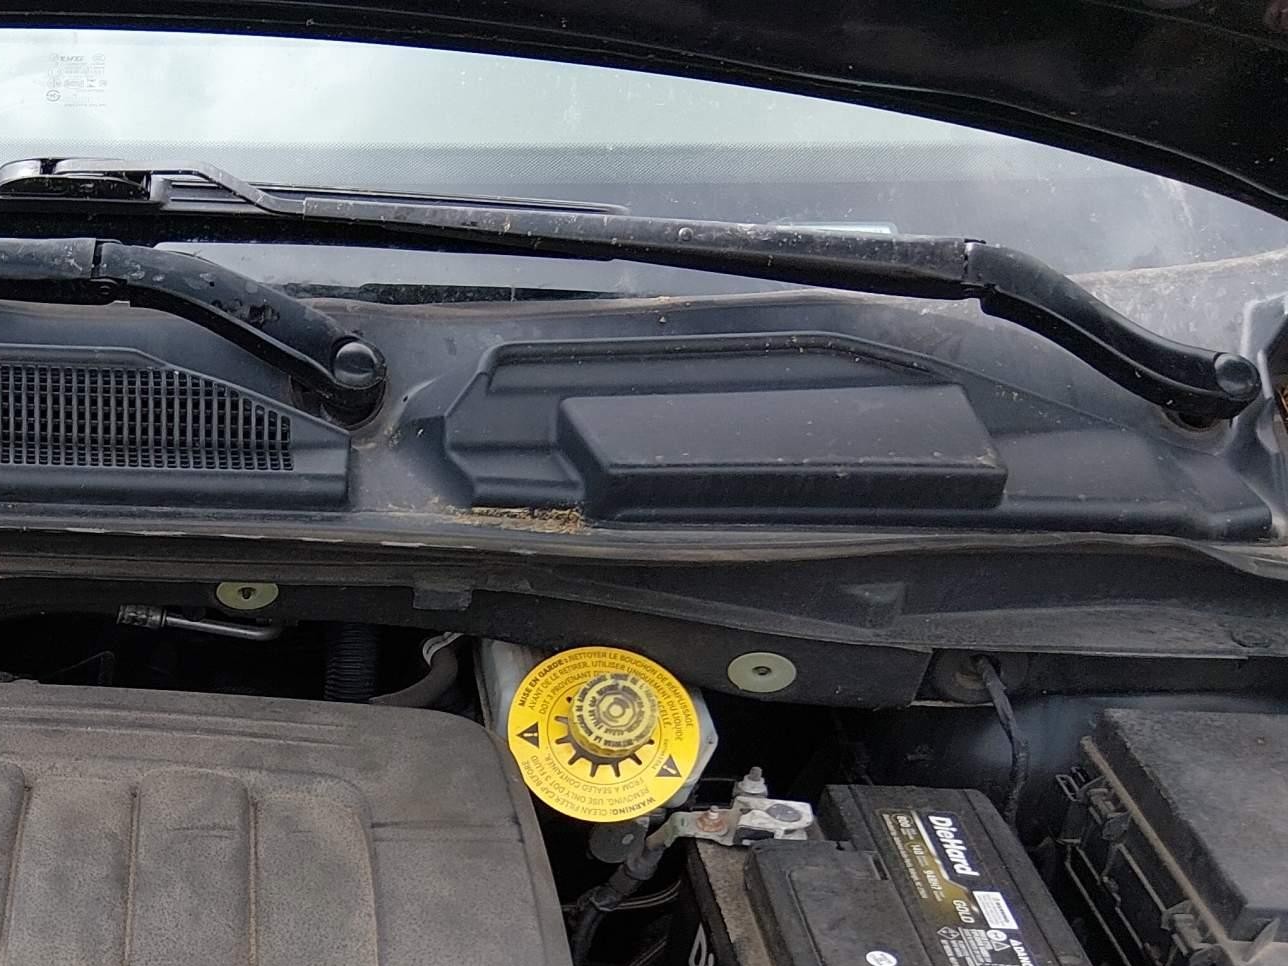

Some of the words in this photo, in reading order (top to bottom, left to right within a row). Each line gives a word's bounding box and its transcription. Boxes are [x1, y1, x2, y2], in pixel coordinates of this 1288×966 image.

[518, 687, 533, 707] MISE
[529, 678, 540, 688] EN
[608, 652, 620, 660] LE
[656, 673, 669, 684] DE
[540, 786, 555, 800] CAP
[549, 780, 565, 795] DOT
[565, 789, 587, 804] ONLY
[586, 797, 604, 806] USE
[555, 796, 580, 813] FILLER
[580, 806, 608, 817] CLEAN
[928, 815, 981, 876] DieHard
[952, 900, 976, 924] GOLD
